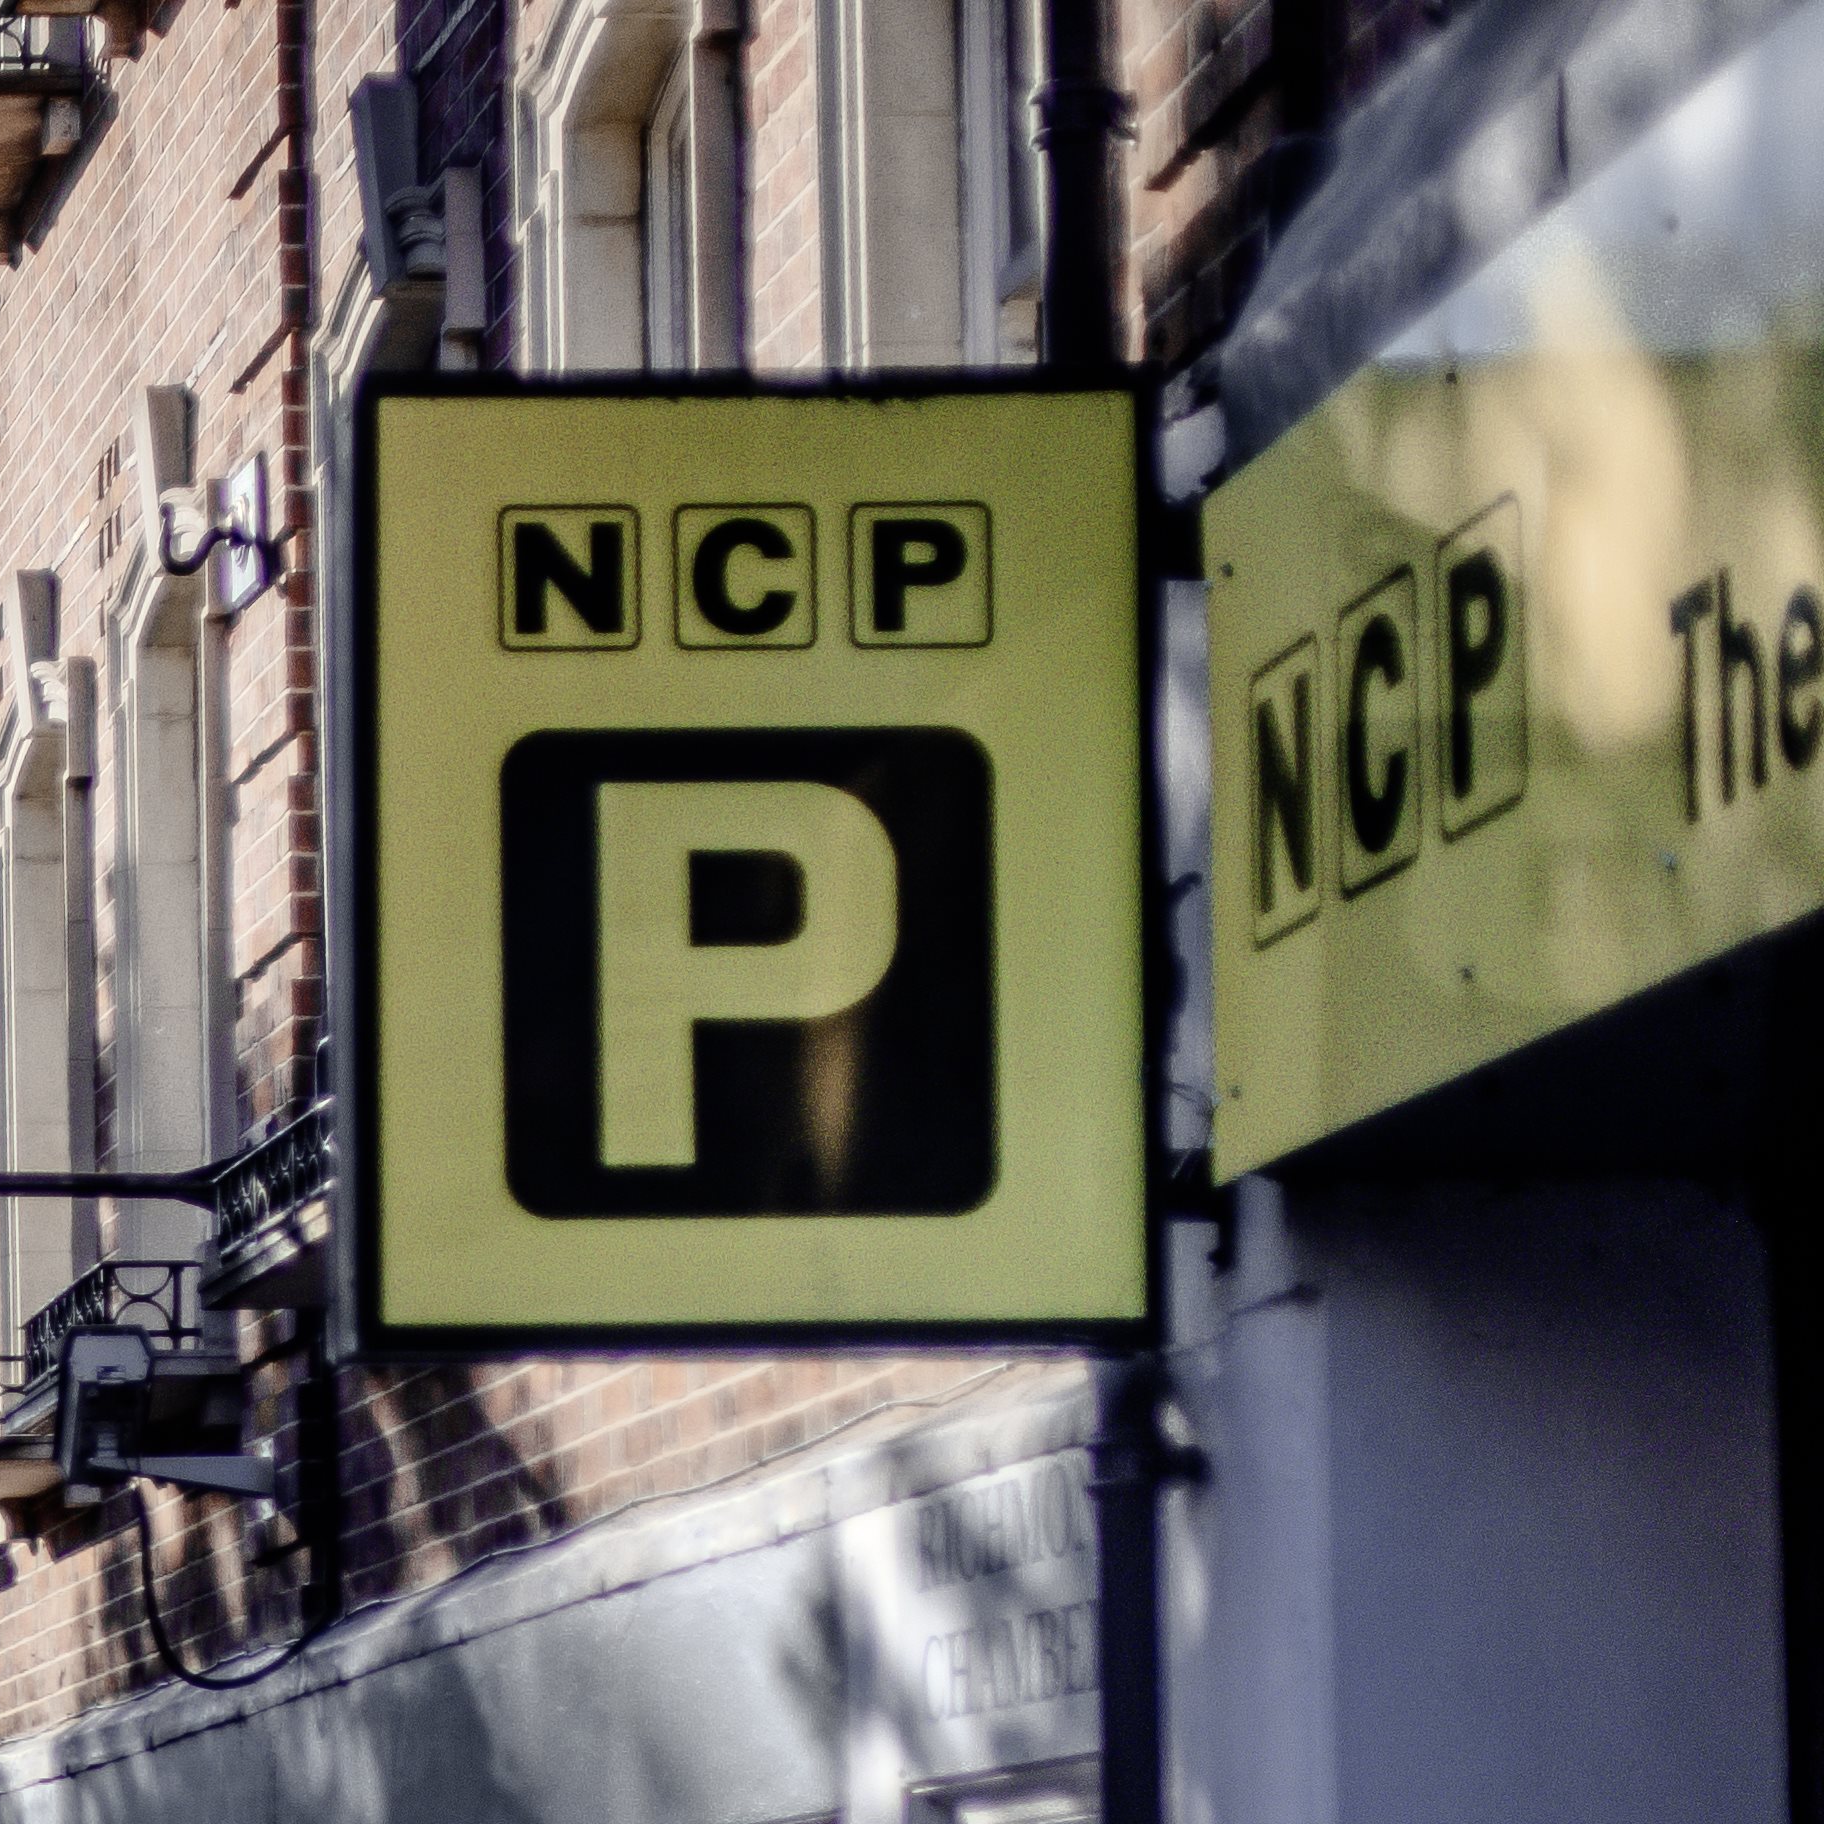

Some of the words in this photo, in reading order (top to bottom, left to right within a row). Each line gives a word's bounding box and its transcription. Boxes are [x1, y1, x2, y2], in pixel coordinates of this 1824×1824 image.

[510, 516, 970, 637] NCP
[1255, 545, 1509, 914] NCP
[1668, 566, 1824, 825] The
[596, 779, 900, 1169] P
